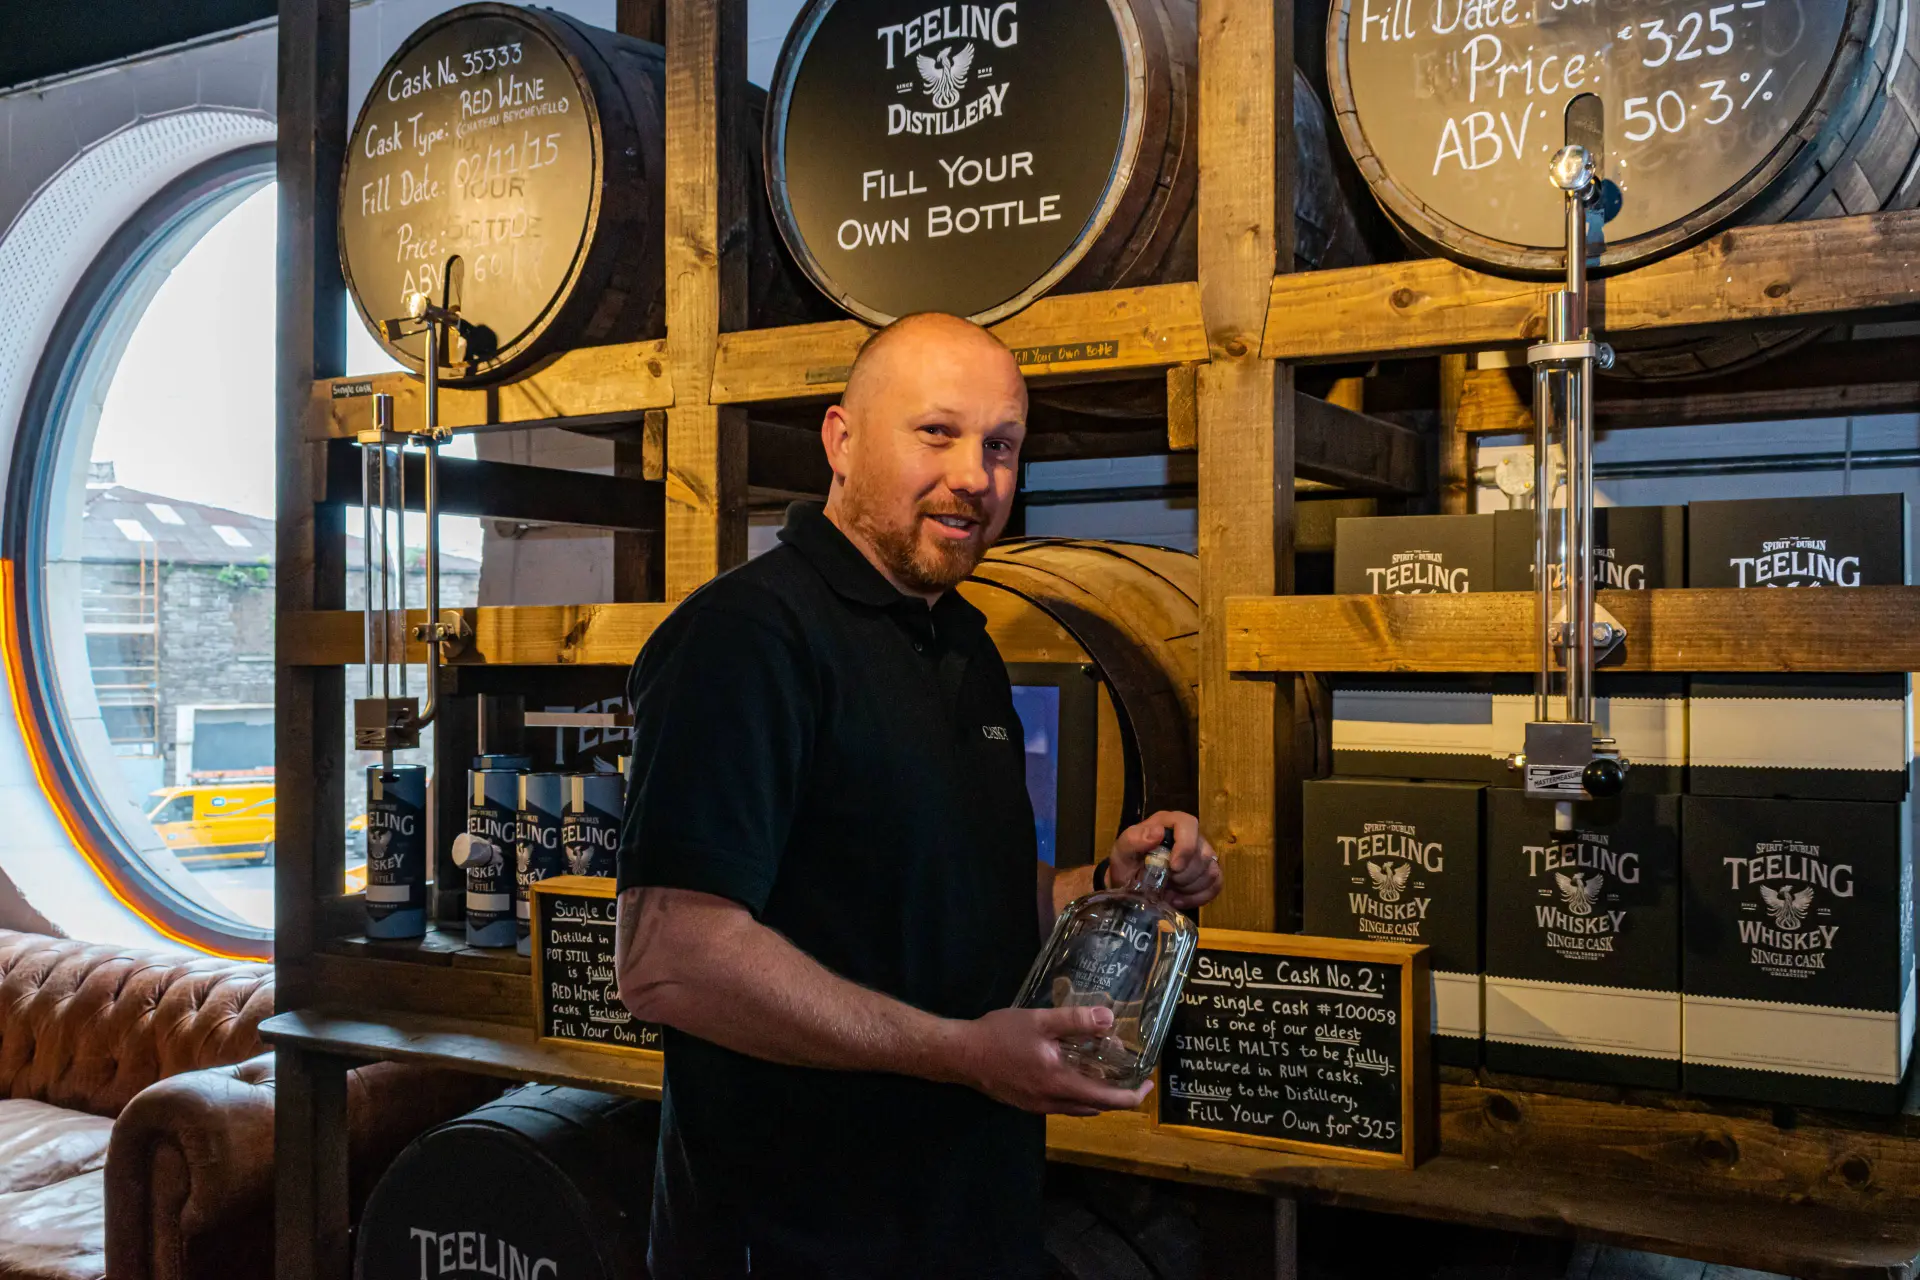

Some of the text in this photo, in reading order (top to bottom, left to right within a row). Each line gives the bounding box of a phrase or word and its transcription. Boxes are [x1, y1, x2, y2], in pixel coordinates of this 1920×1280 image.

[877, 1, 1019, 70] TEELING
[388, 66, 432, 101] Cask
[461, 43, 522, 77] 35333
[1462, 34, 1601, 103] Price:
[365, 125, 402, 159] Cask
[407, 112, 449, 157] Type:
[460, 88, 492, 120] RED
[499, 74, 545, 108] WINE
[888, 82, 1010, 136] DISTILLERY
[1432, 97, 1549, 176] ABV:
[362, 130, 561, 217] Fill Date: 02/11/15
[863, 151, 1034, 202] FILL YOUR
[837, 194, 1062, 251] OWN BOTTLE
[397, 223, 446, 263] Price:
[1032, 348, 1053, 362] Your
[1059, 347, 1080, 360] Own
[1086, 343, 1113, 357] Bottle
[332, 385, 354, 397] Single
[1762, 540, 1790, 552] SPIRIT
[1796, 540, 1826, 551] DUBLIN
[1366, 563, 1469, 594] TEELING
[1730, 551, 1860, 588] TEELING
[1534, 771, 1582, 787] MASTERMEASURE
[369, 811, 414, 835] ELING
[468, 817, 516, 843] ELING
[1364, 823, 1386, 833] SPIRIT
[1391, 825, 1415, 836] DUBLIN
[1337, 834, 1444, 872] TEELING
[1756, 843, 1783, 854] SPIRIT
[1789, 844, 1819, 856] DUBLIN
[1522, 844, 1639, 883] TEELING
[1723, 855, 1853, 897] TEELING
[555, 900, 599, 926] Single
[1349, 893, 1431, 920] WHISKEY
[1360, 918, 1419, 936] SINGLE CASK
[1535, 906, 1627, 934] WHISKEY
[552, 930, 609, 944] Distilled in
[1547, 932, 1613, 951] SINGLE CASK
[1738, 920, 1839, 950] WHISKEY
[547, 948, 563, 961] POT
[565, 949, 590, 963] STILL
[1077, 956, 1129, 977] HISKEY
[1751, 948, 1826, 968] SINGLE CASK
[568, 966, 614, 985] is fully
[1198, 957, 1264, 989] Single
[1276, 961, 1320, 985] Cask
[552, 982, 571, 999] RED
[574, 983, 600, 1001] WINE
[553, 1004, 632, 1020] casks. Exclusive
[1213, 993, 1264, 1017] single
[1272, 1000, 1309, 1016] cask
[552, 1020, 659, 1044] Fill Your Own for
[1206, 1016, 1362, 1041] is one of our oldest
[1176, 1034, 1390, 1076] SINGLE MALTS to be fully
[1180, 1056, 1363, 1086] matured in RUM casks.
[1169, 1075, 1232, 1098] Exclusive
[1238, 1083, 1255, 1098] to
[1257, 1083, 1279, 1099] the
[1188, 1101, 1224, 1121] Fill
[1231, 1104, 1274, 1125] Your
[1282, 1110, 1320, 1134] Own
[1326, 1115, 1352, 1137] for
